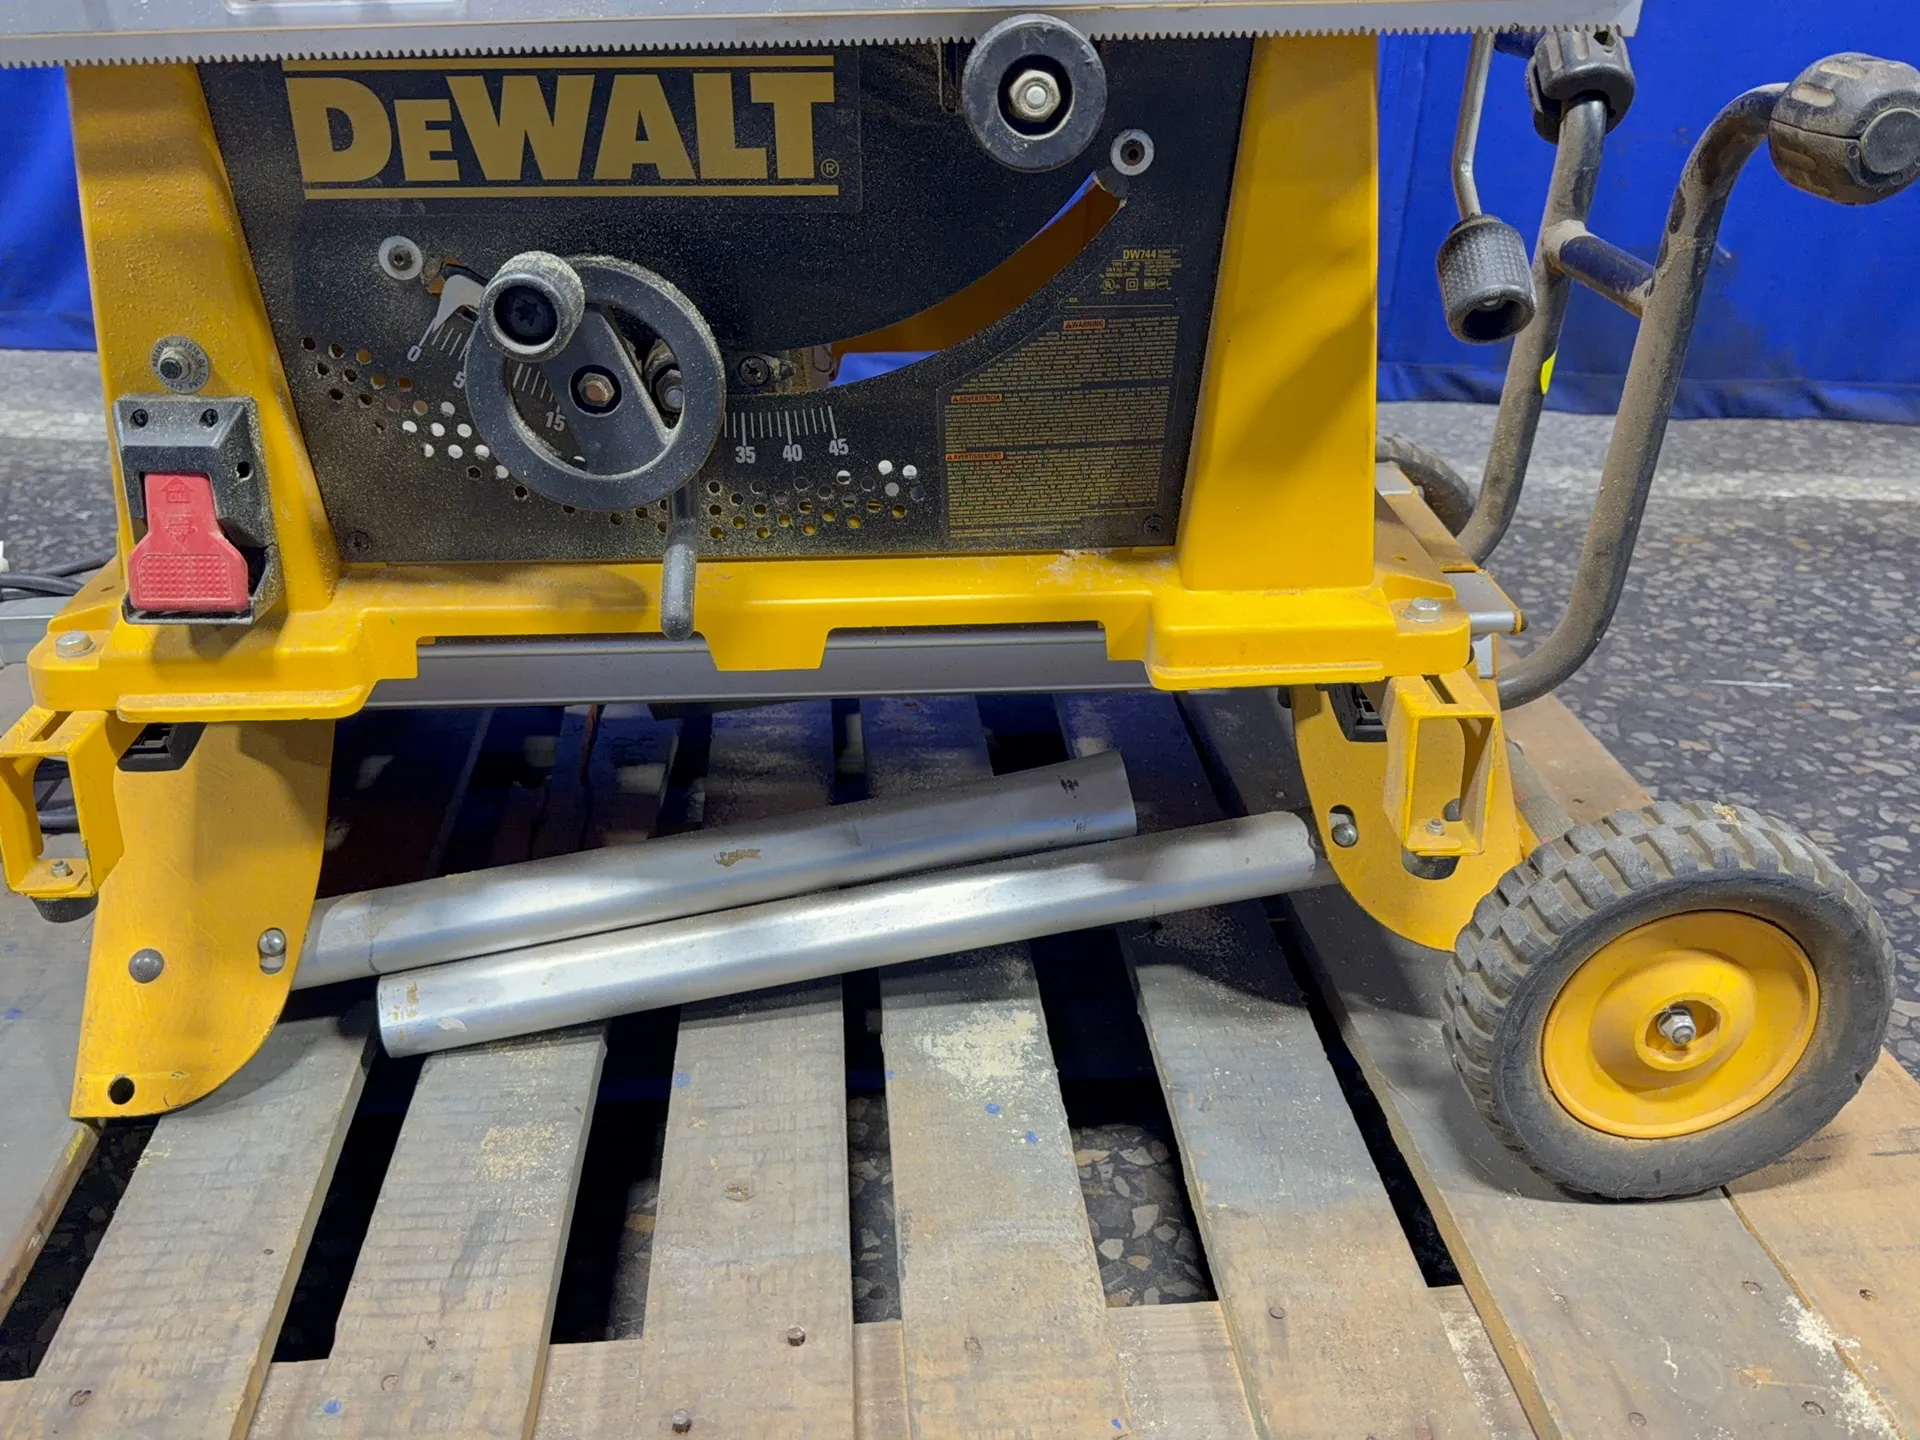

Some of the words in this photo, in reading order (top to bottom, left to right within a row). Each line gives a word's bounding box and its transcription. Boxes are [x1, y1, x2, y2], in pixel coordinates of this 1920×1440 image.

[285, 72, 835, 182] DEWALT
[1123, 249, 1157, 260] DW744
[1072, 320, 1104, 329] WARNING
[407, 345, 421, 362] 0
[188, 372, 206, 389] PRESS
[453, 371, 466, 389] 5
[545, 411, 566, 431] 15
[735, 446, 756, 464] 35
[782, 444, 803, 462] 40
[828, 438, 849, 456] 45
[953, 452, 1003, 460] AVERTISSEMENT
